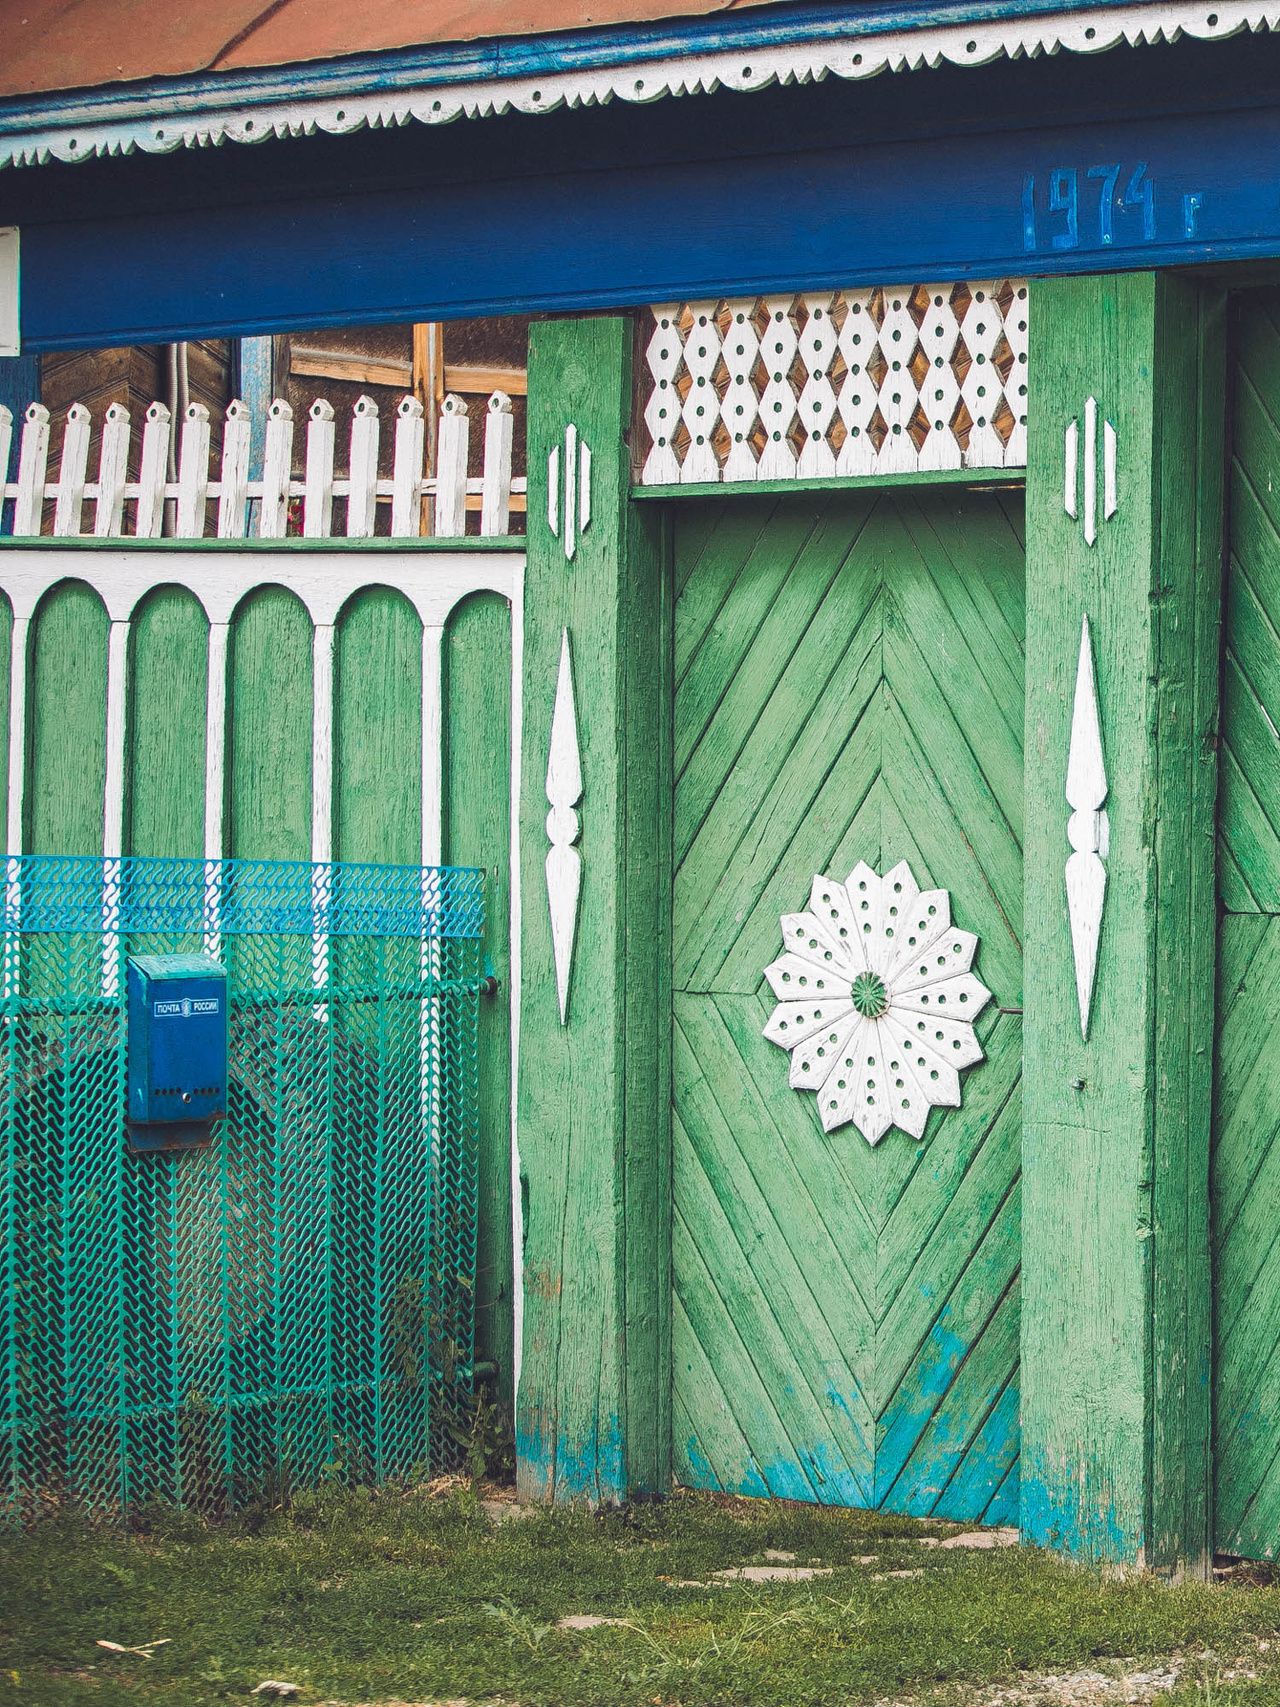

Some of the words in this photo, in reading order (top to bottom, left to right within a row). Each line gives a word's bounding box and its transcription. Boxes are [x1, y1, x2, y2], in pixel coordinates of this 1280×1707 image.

[1021, 161, 1156, 250] 1974
[157, 1003, 181, 1014] ПОЧТА
[193, 1001, 217, 1011] РОССИИ
